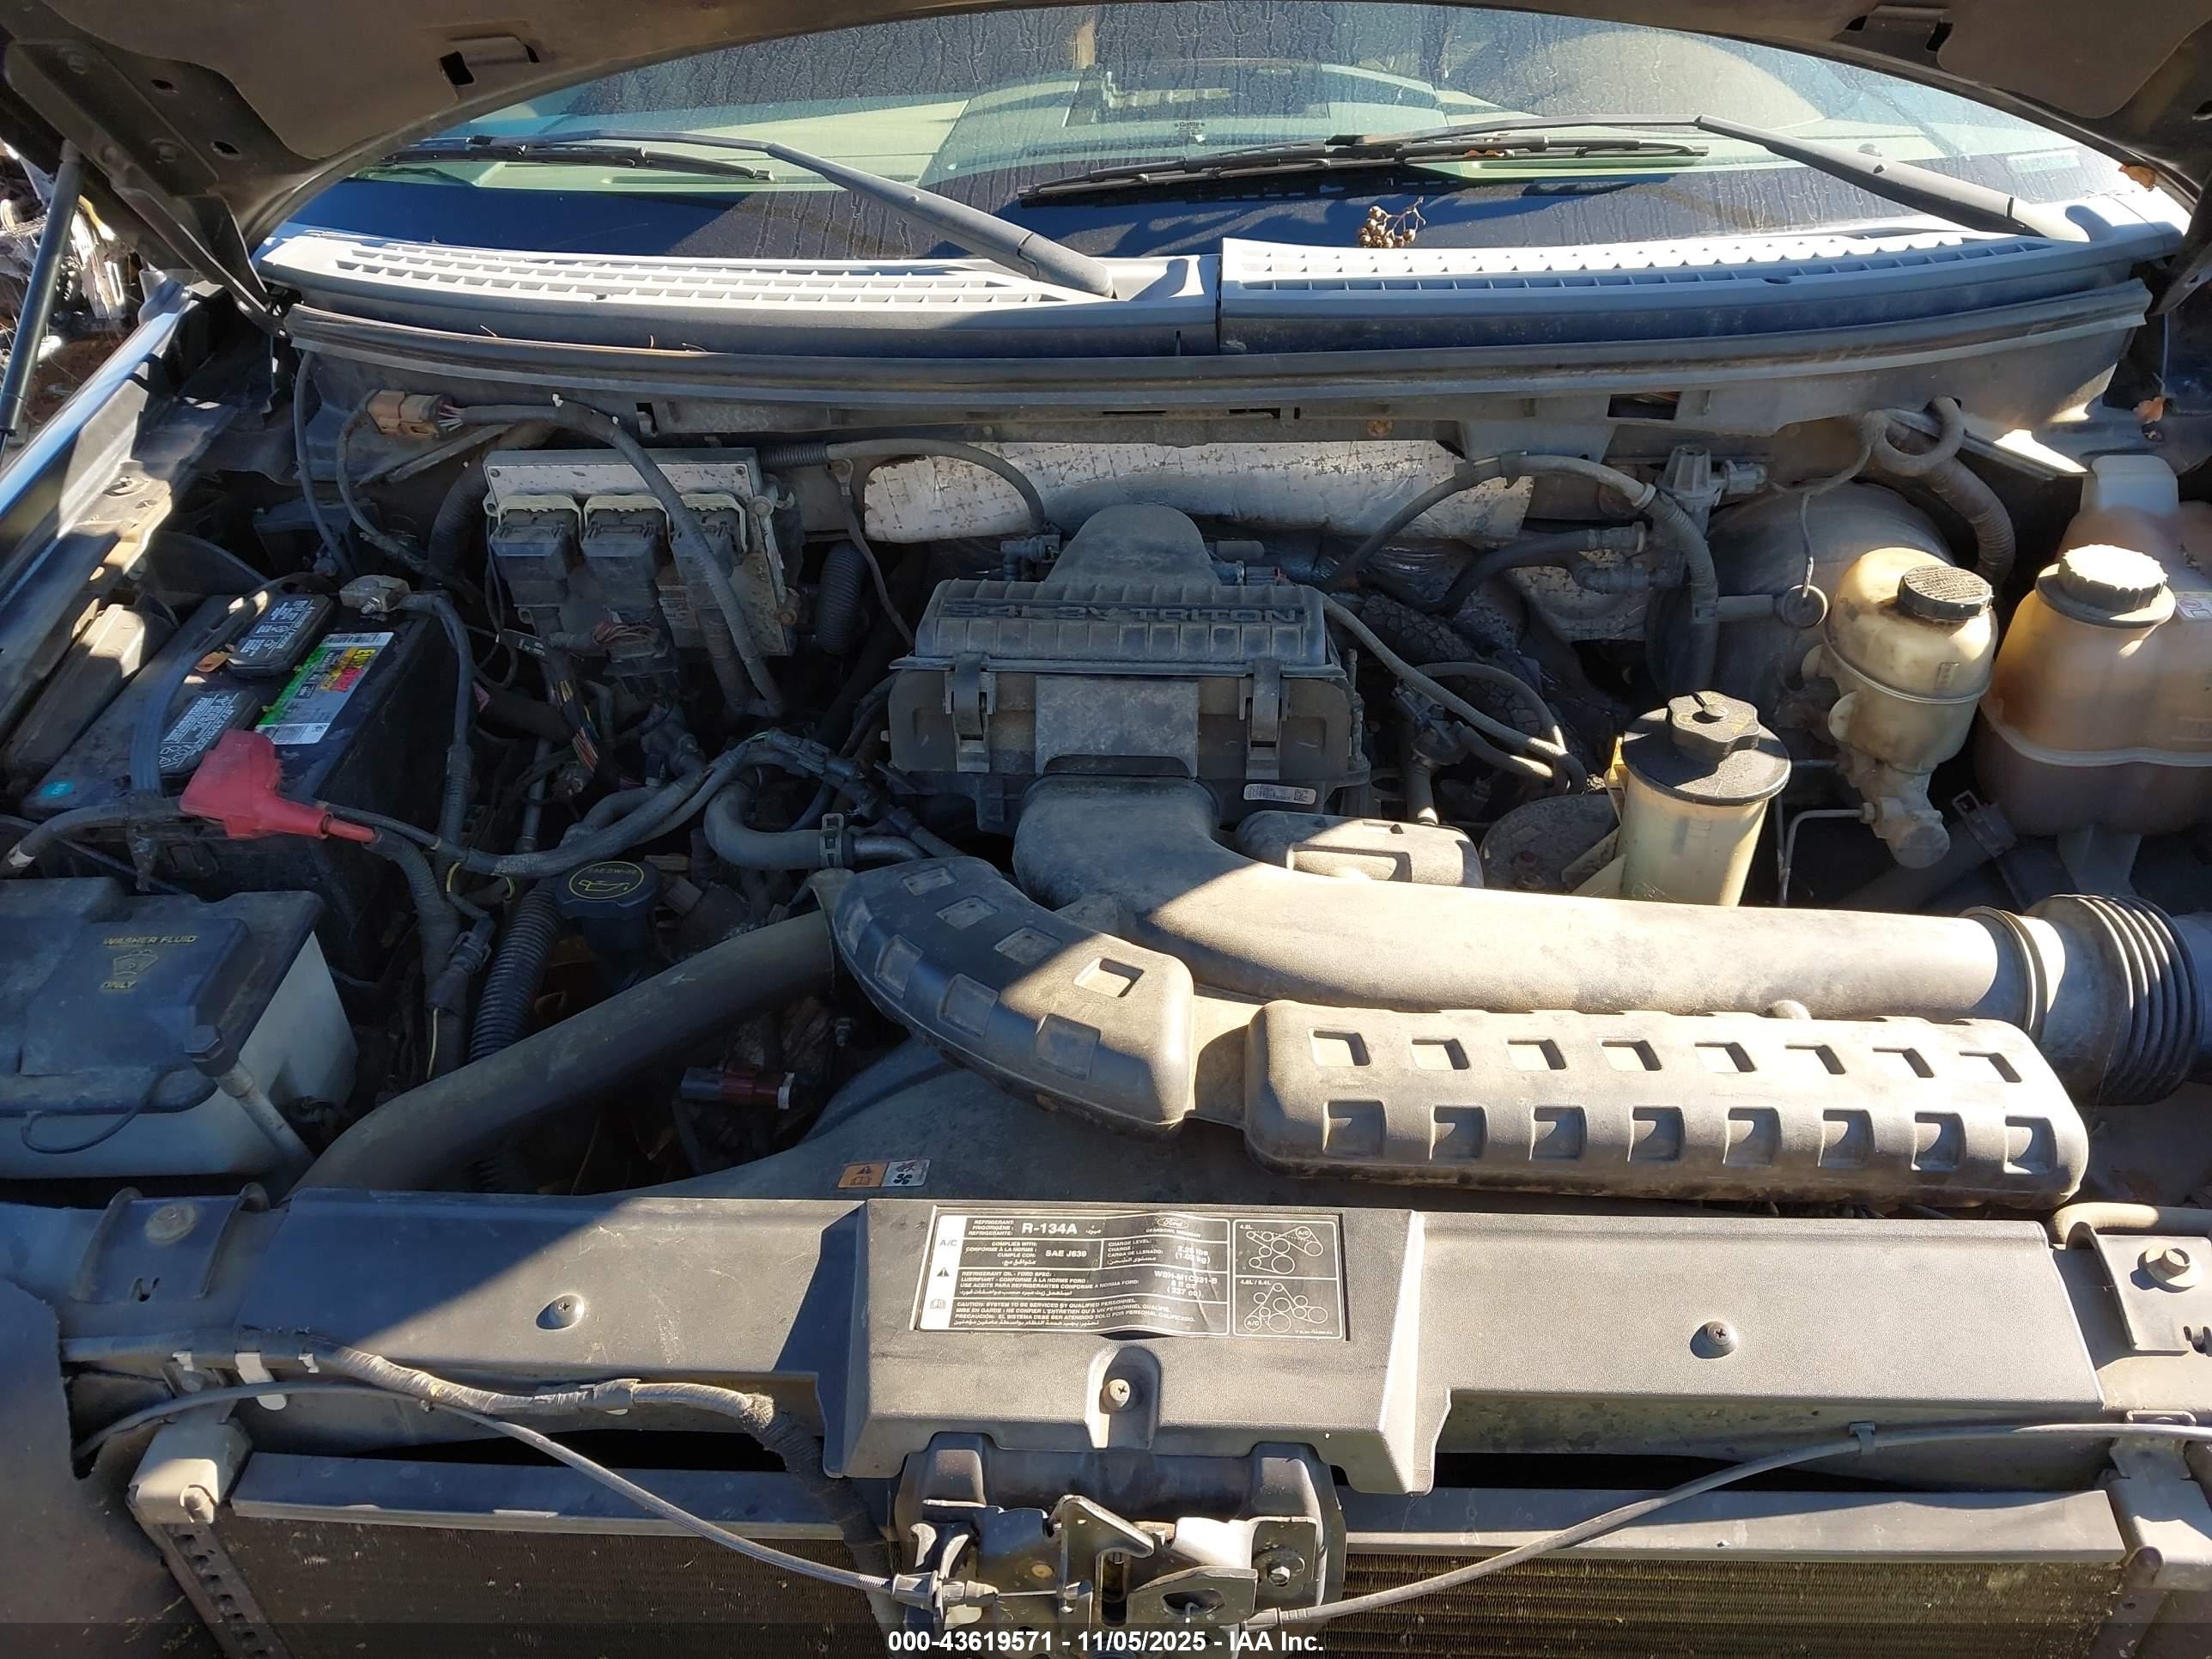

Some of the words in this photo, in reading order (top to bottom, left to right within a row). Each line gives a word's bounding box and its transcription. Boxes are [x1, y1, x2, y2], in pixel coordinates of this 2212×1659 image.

[1129, 607, 1297, 623] TRITON
[103, 937, 158, 945] WASHER
[159, 935, 198, 944] FLUID
[100, 981, 137, 989] ONLY
[1021, 1222, 1079, 1235] R-134A
[1101, 1298, 1137, 1307] PERSONNEL.
